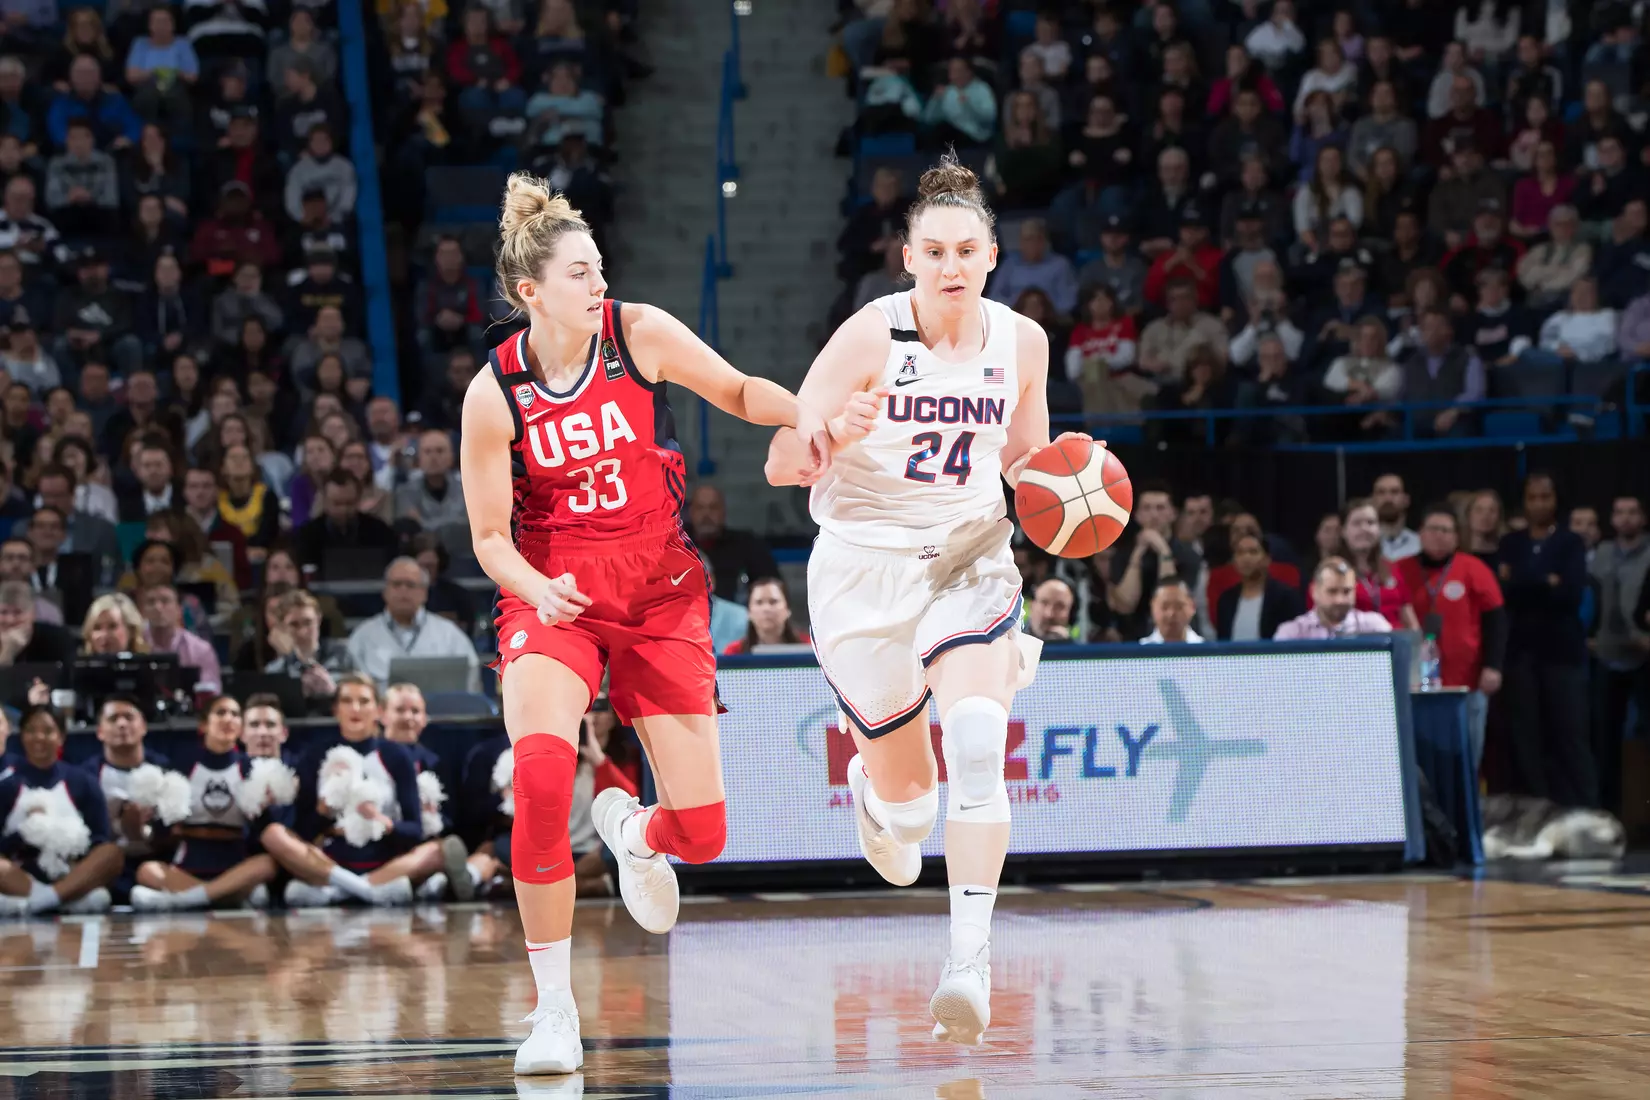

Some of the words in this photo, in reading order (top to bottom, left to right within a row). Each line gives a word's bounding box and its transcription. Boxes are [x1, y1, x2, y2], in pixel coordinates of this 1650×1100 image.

[528, 400, 637, 468] USA
[887, 394, 1005, 425] UCONN
[566, 458, 628, 513] 33
[904, 431, 976, 486] 24
[918, 552, 940, 560] UCONN
[1038, 723, 1160, 779] FLY
